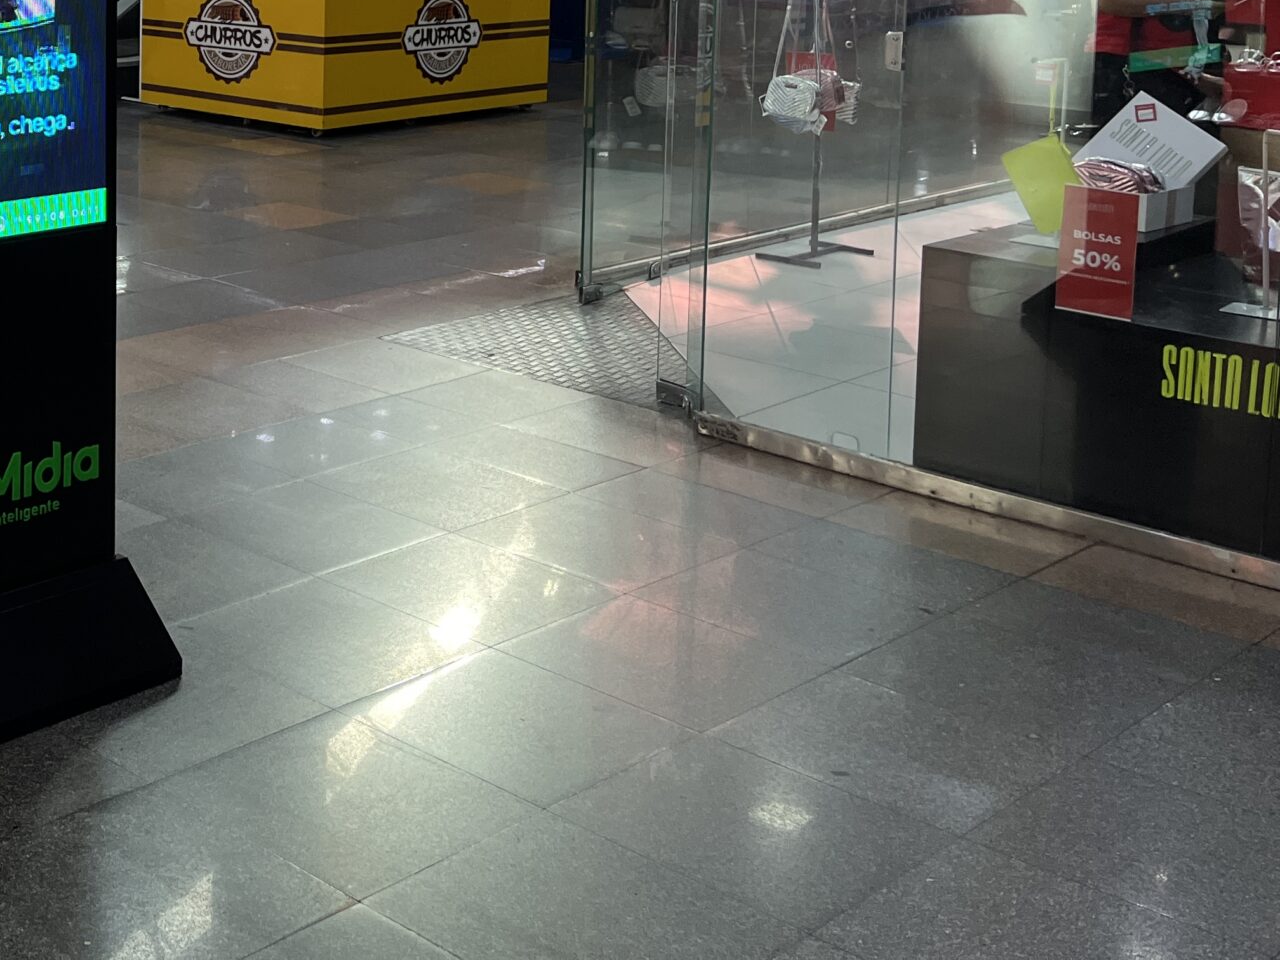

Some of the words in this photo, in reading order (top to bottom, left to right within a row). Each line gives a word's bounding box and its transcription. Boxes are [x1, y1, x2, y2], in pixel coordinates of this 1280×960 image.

[195, 24, 263, 48] CHURROS
[412, 24, 472, 47] CHURROS
[1073, 229, 1122, 245] BOLSAS
[1071, 248, 1122, 272] 50%
[1161, 344, 1243, 410] SANTA
[1248, 359, 1280, 419] LO
